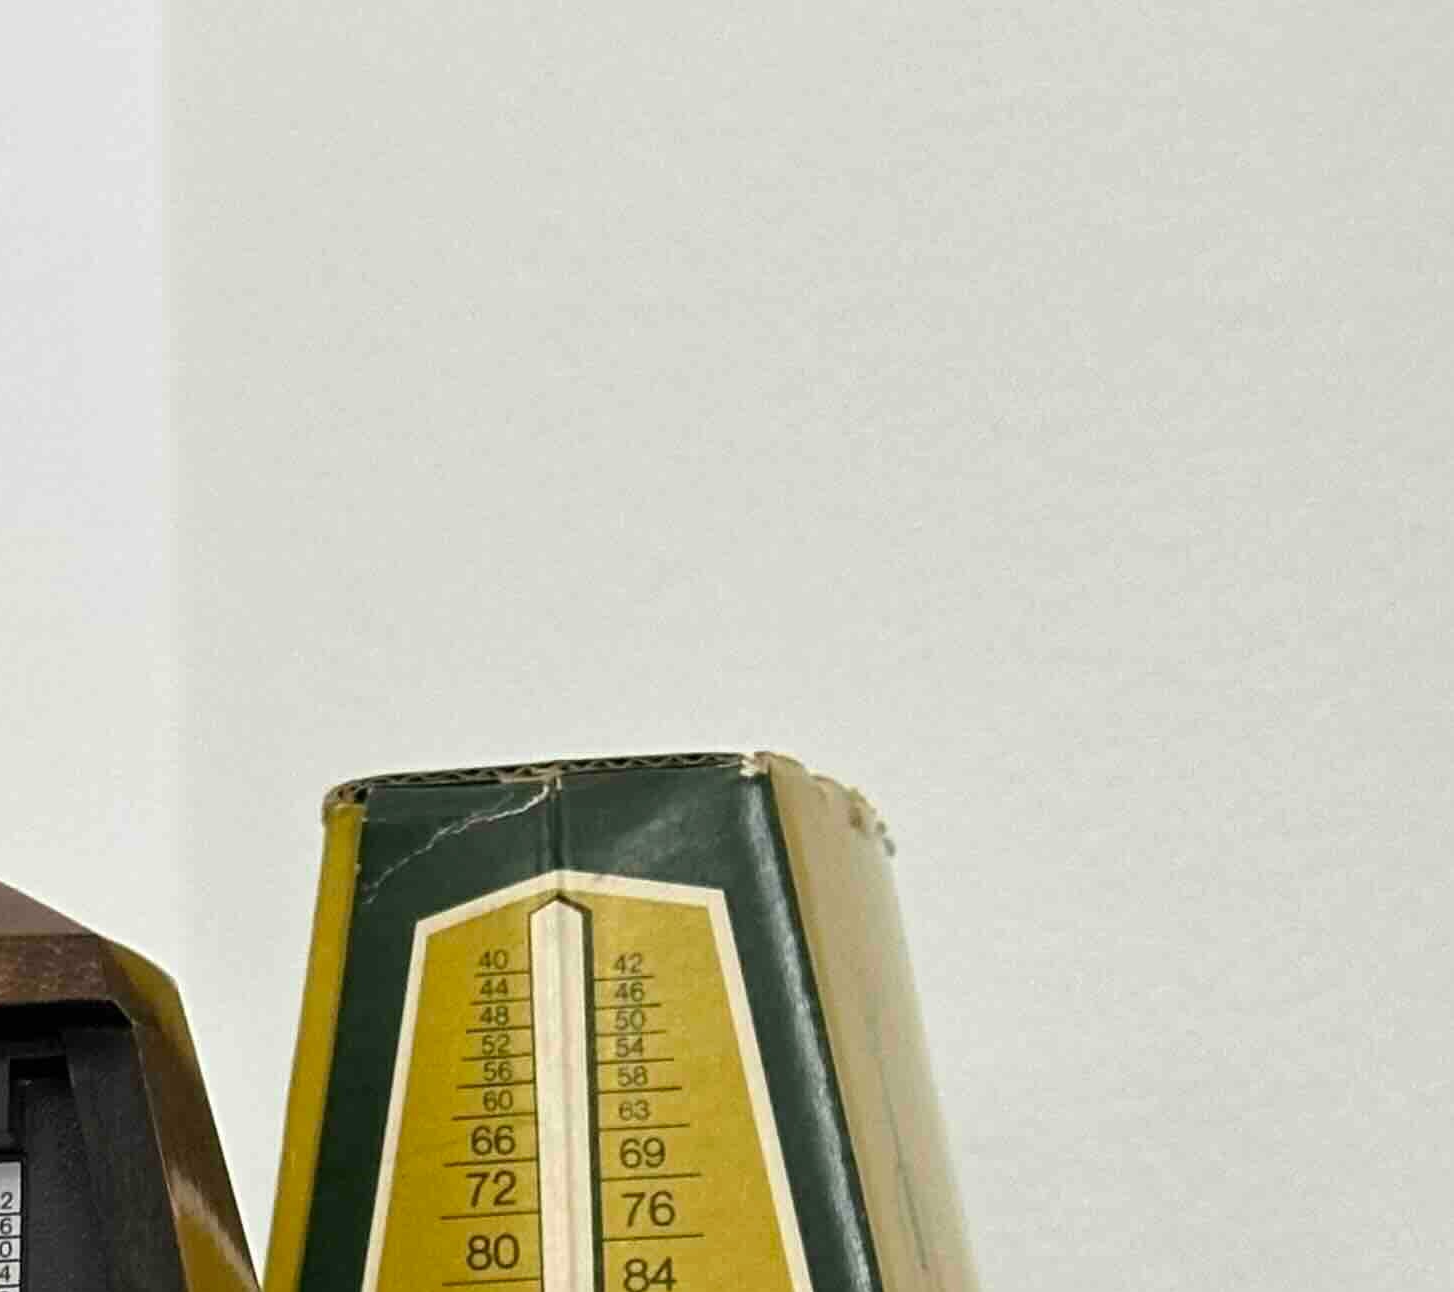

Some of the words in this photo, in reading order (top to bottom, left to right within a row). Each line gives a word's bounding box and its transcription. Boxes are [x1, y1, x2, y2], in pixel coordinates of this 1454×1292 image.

[479, 950, 508, 969] 40
[614, 953, 643, 974] 42
[480, 979, 508, 997] 44
[614, 982, 644, 1001] 46
[480, 1006, 508, 1025] 48
[616, 1010, 645, 1031] 50
[482, 1035, 510, 1055] 52
[616, 1037, 644, 1058] 54
[483, 1062, 513, 1082] 56
[618, 1066, 648, 1087] 58
[483, 1090, 513, 1112] 60
[619, 1100, 650, 1121] 63
[471, 1125, 516, 1155] 66
[620, 1137, 665, 1169] 69
[466, 1171, 516, 1207] 72
[622, 1191, 676, 1228] 76
[466, 1233, 519, 1270] 80
